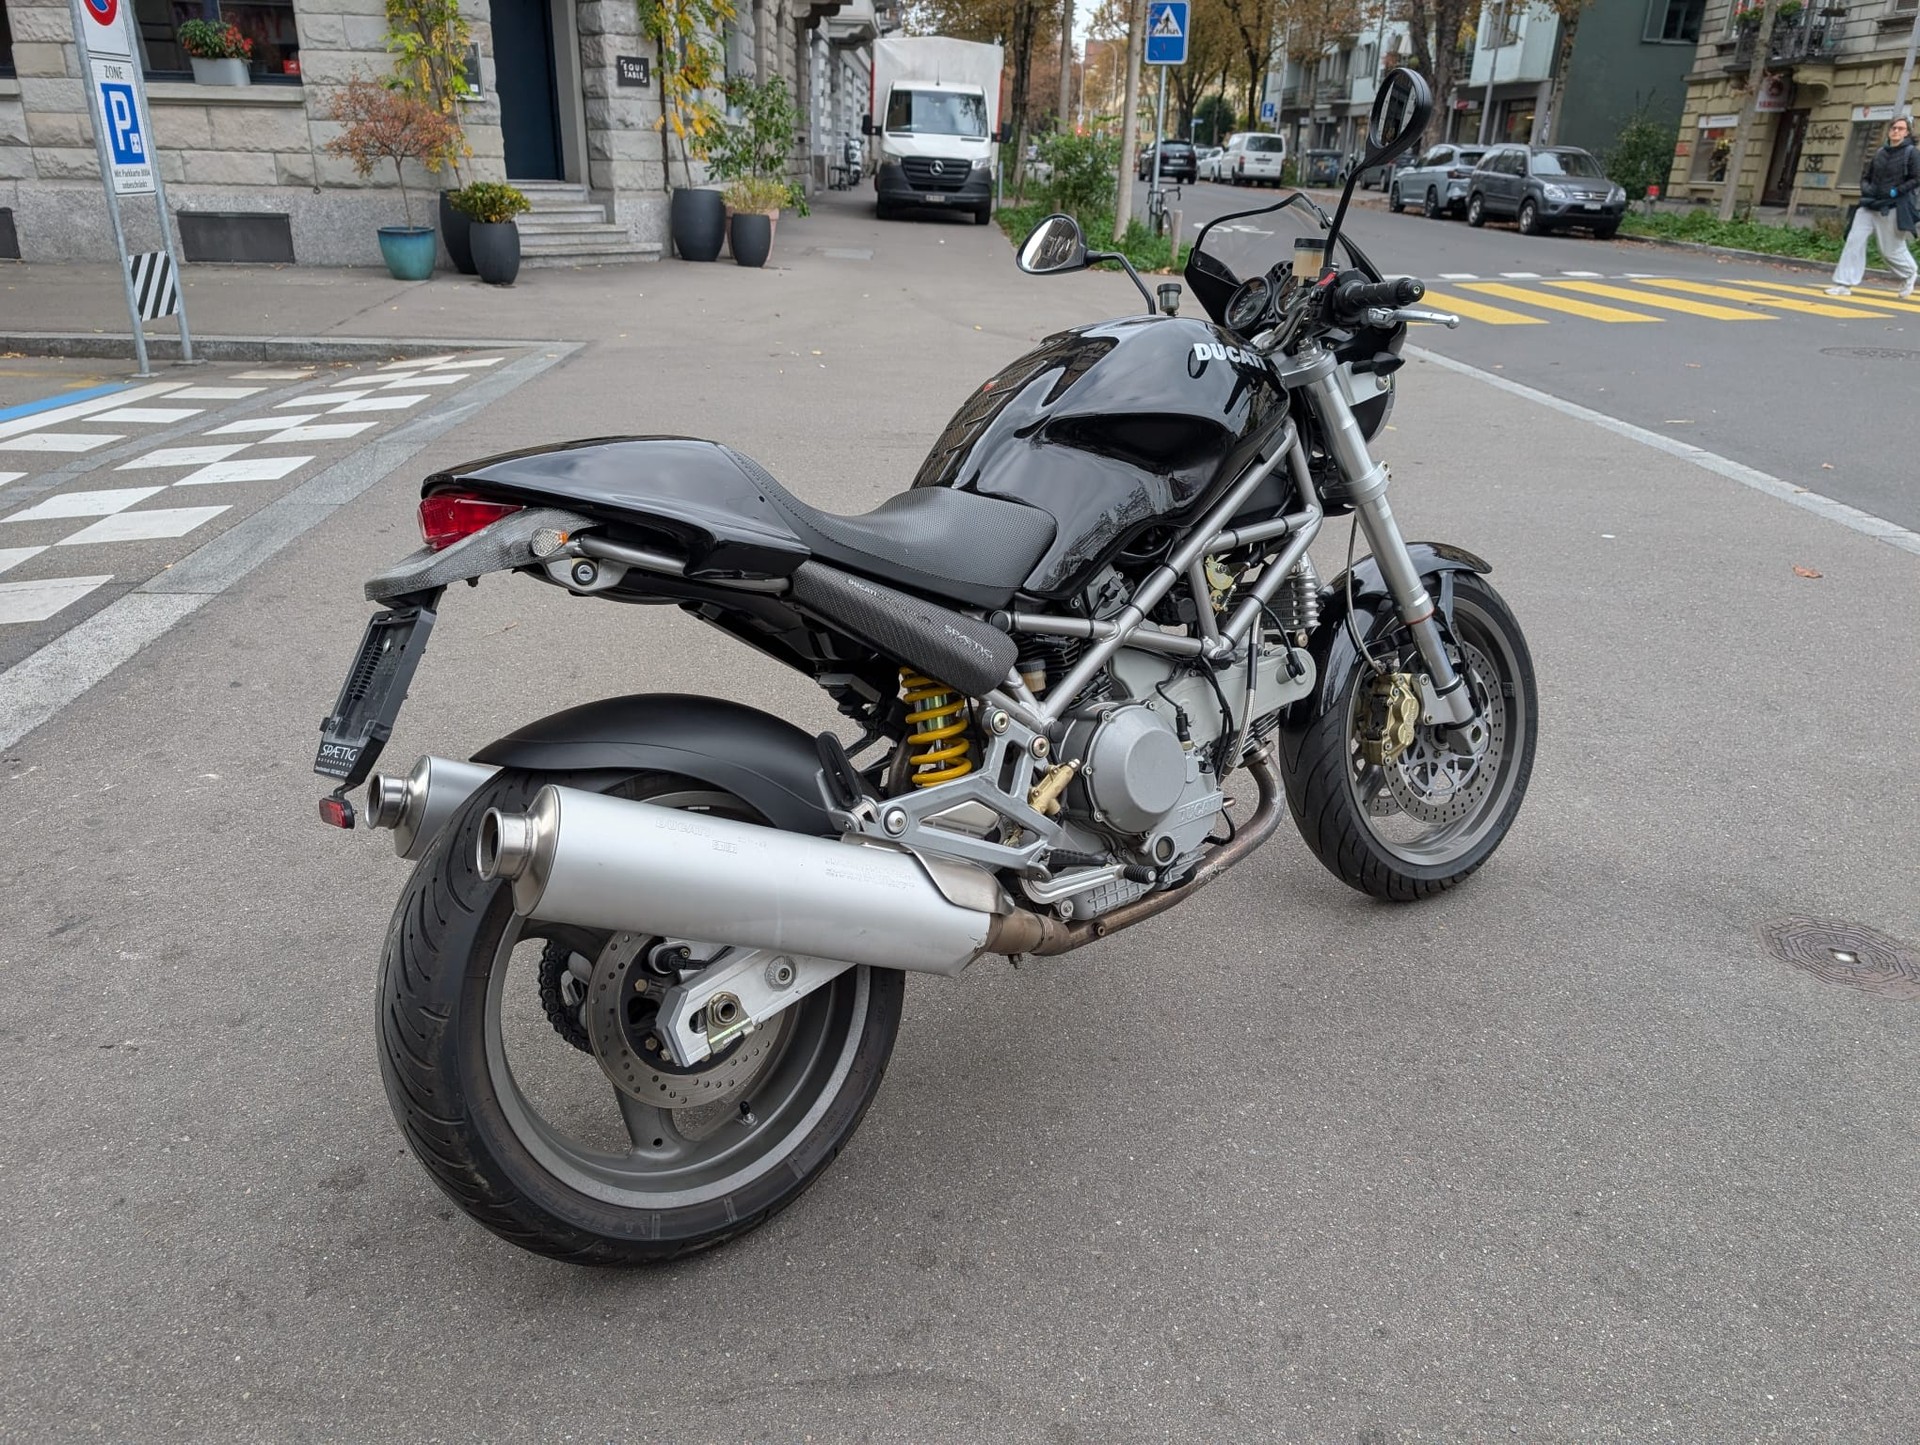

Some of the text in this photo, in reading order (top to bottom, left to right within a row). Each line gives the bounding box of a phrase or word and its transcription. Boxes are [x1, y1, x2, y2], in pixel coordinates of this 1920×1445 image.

[104, 65, 124, 80] ZONE
[623, 63, 643, 71] EQUI
[624, 71, 644, 80] TABLE
[109, 91, 132, 151] P
[1193, 343, 1267, 371] DUCATI
[848, 578, 877, 596] DUCATI
